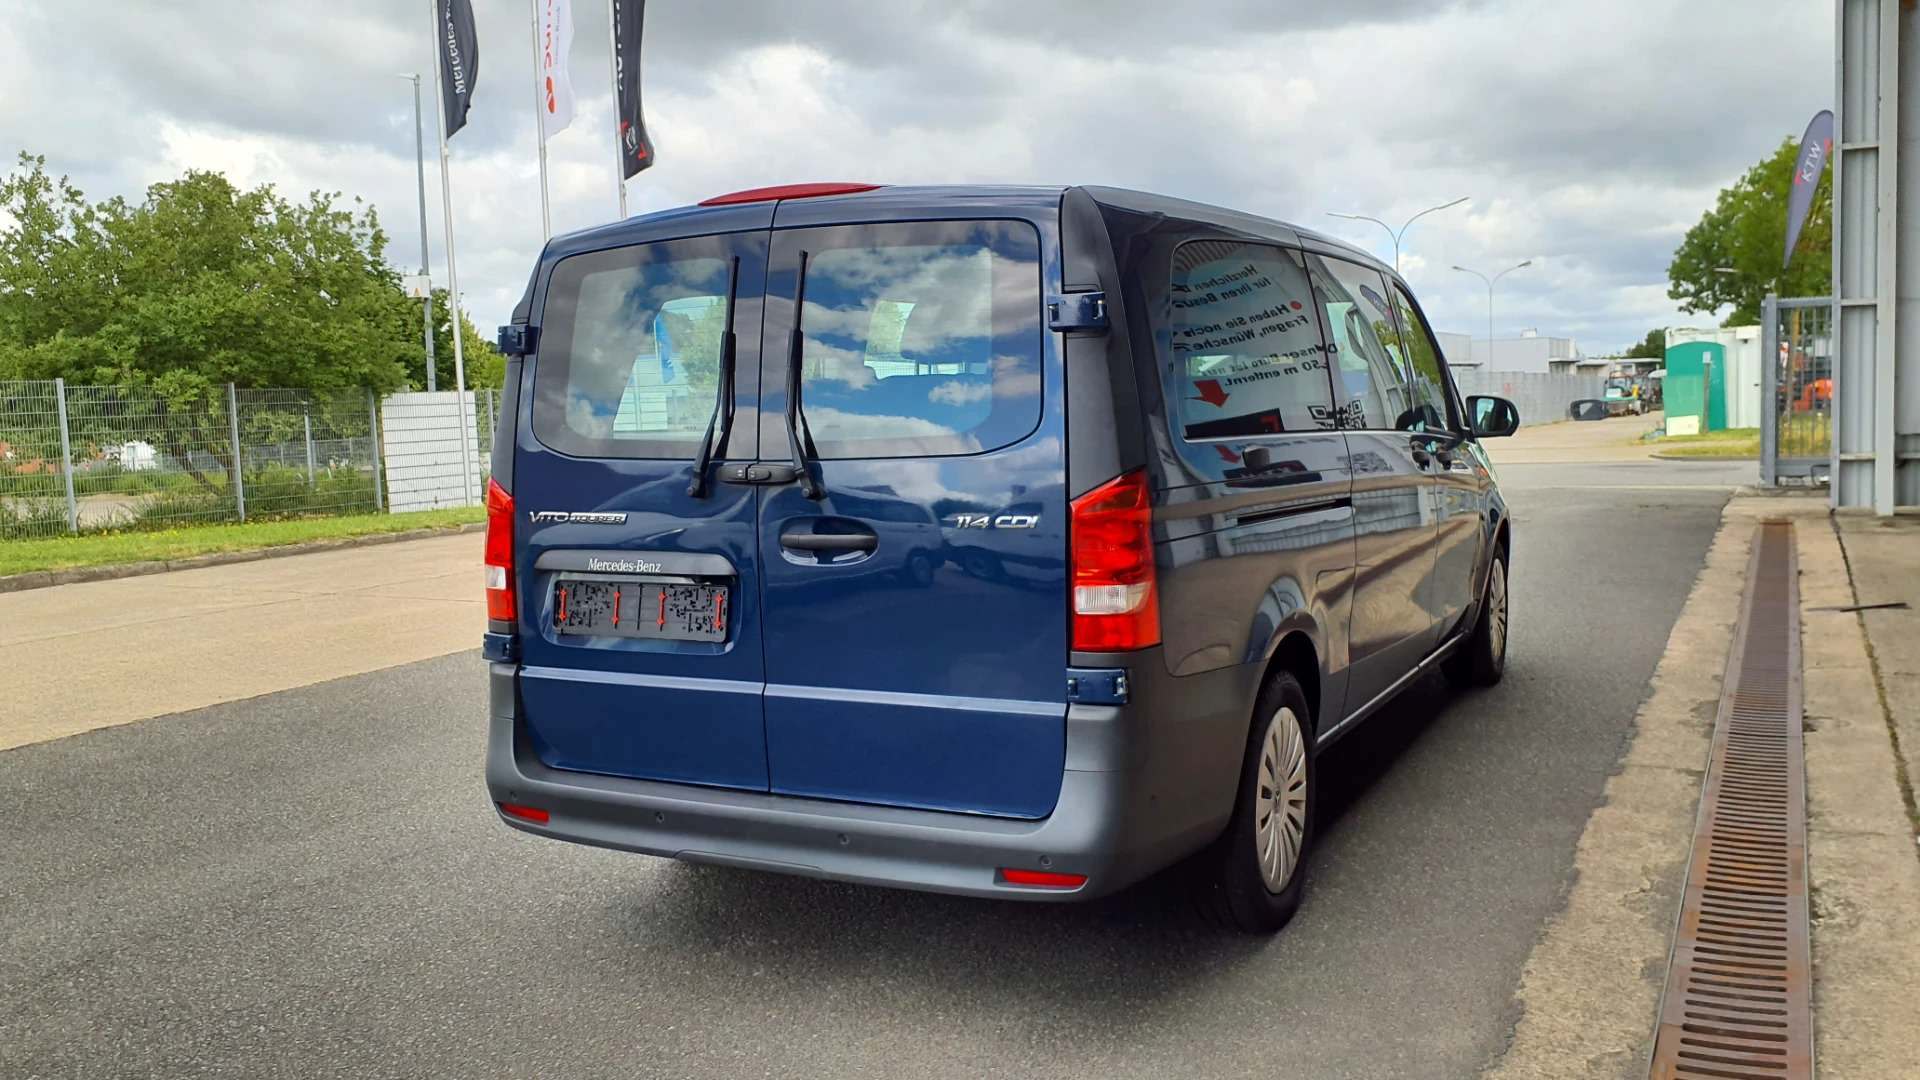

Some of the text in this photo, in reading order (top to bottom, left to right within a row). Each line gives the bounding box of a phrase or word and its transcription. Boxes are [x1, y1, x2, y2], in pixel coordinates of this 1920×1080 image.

[1801, 141, 1821, 183] KTW
[529, 511, 569, 523] VITO
[956, 515, 1039, 528] 114 CDI
[588, 557, 662, 574] Mercedes-Benz
